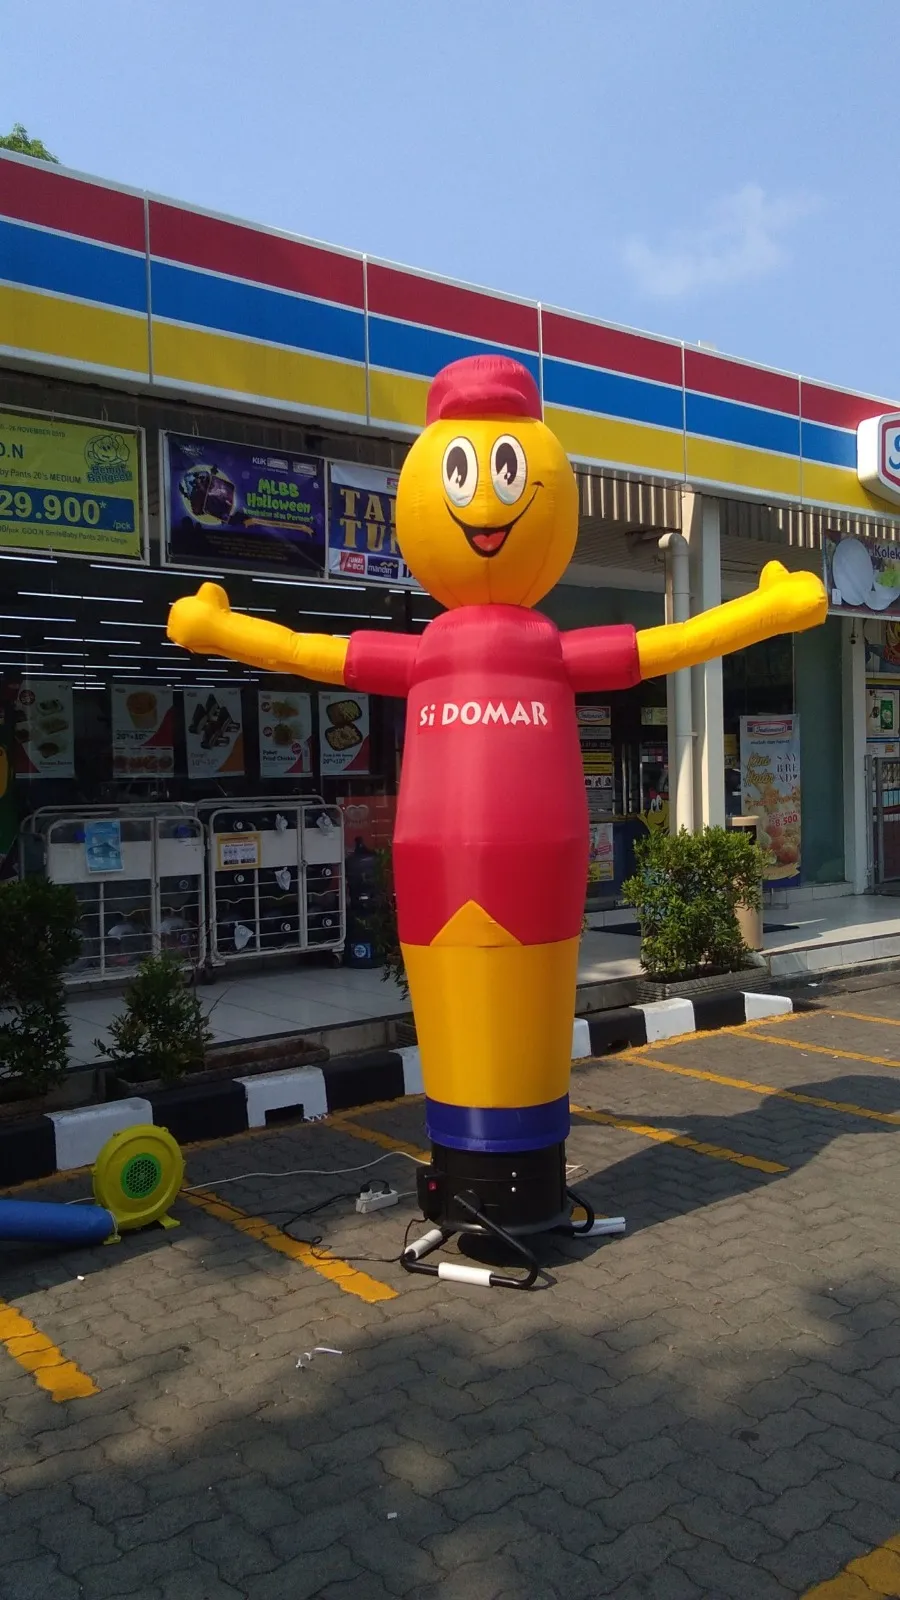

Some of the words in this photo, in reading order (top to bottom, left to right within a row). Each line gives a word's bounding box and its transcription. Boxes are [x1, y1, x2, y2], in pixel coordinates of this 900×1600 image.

[10, 468, 32, 478] Pants
[49, 473, 82, 484] MEDIUM
[257, 478, 300, 498] MLBB
[246, 492, 312, 514] Halloween
[419, 703, 436, 726] Si
[441, 700, 549, 726] DOMAR
